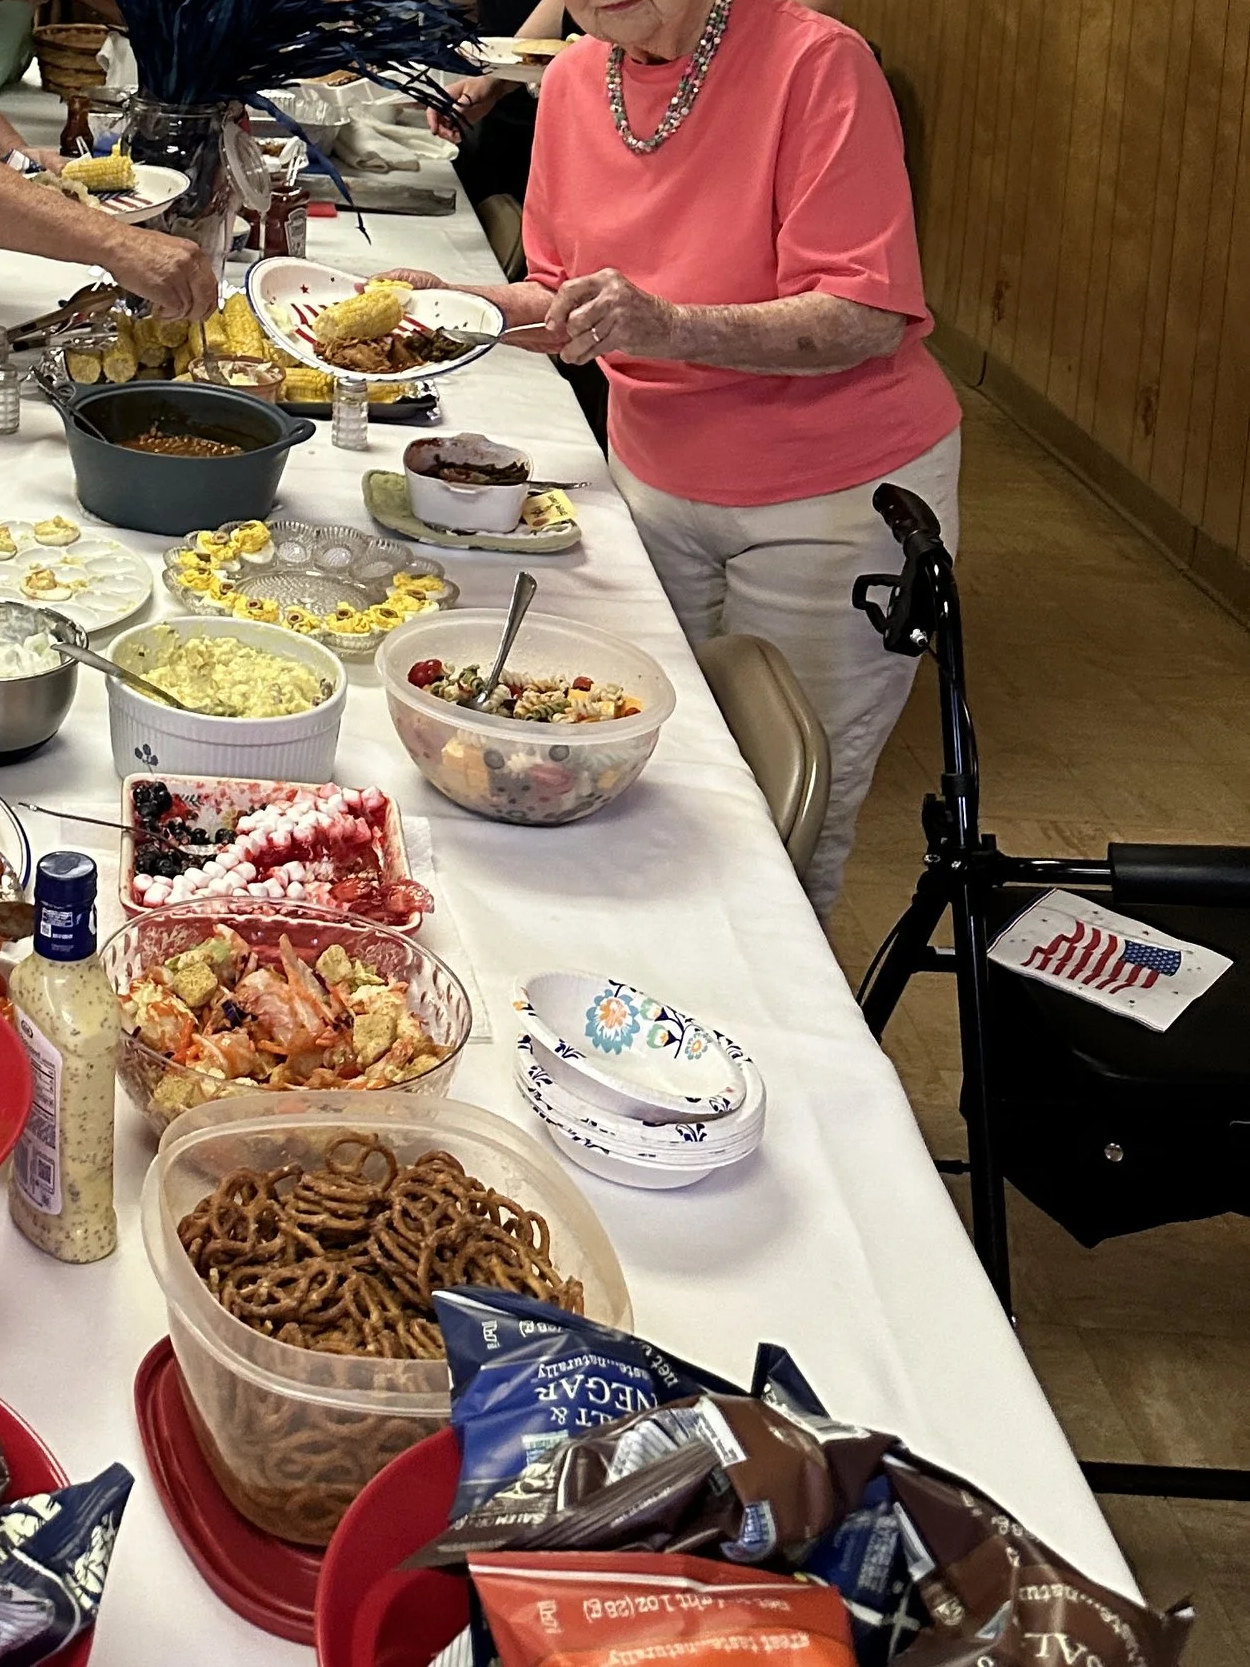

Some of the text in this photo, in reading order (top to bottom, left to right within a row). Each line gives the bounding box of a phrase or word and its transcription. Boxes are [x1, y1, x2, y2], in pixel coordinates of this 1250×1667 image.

[536, 1353, 650, 1380] aste...naturally
[649, 1355, 680, 1388] net
[533, 1374, 659, 1412] NEGAR
[550, 1406, 568, 1425] &
[495, 1512, 546, 1526] SALEM
[604, 1595, 636, 1619] (28
